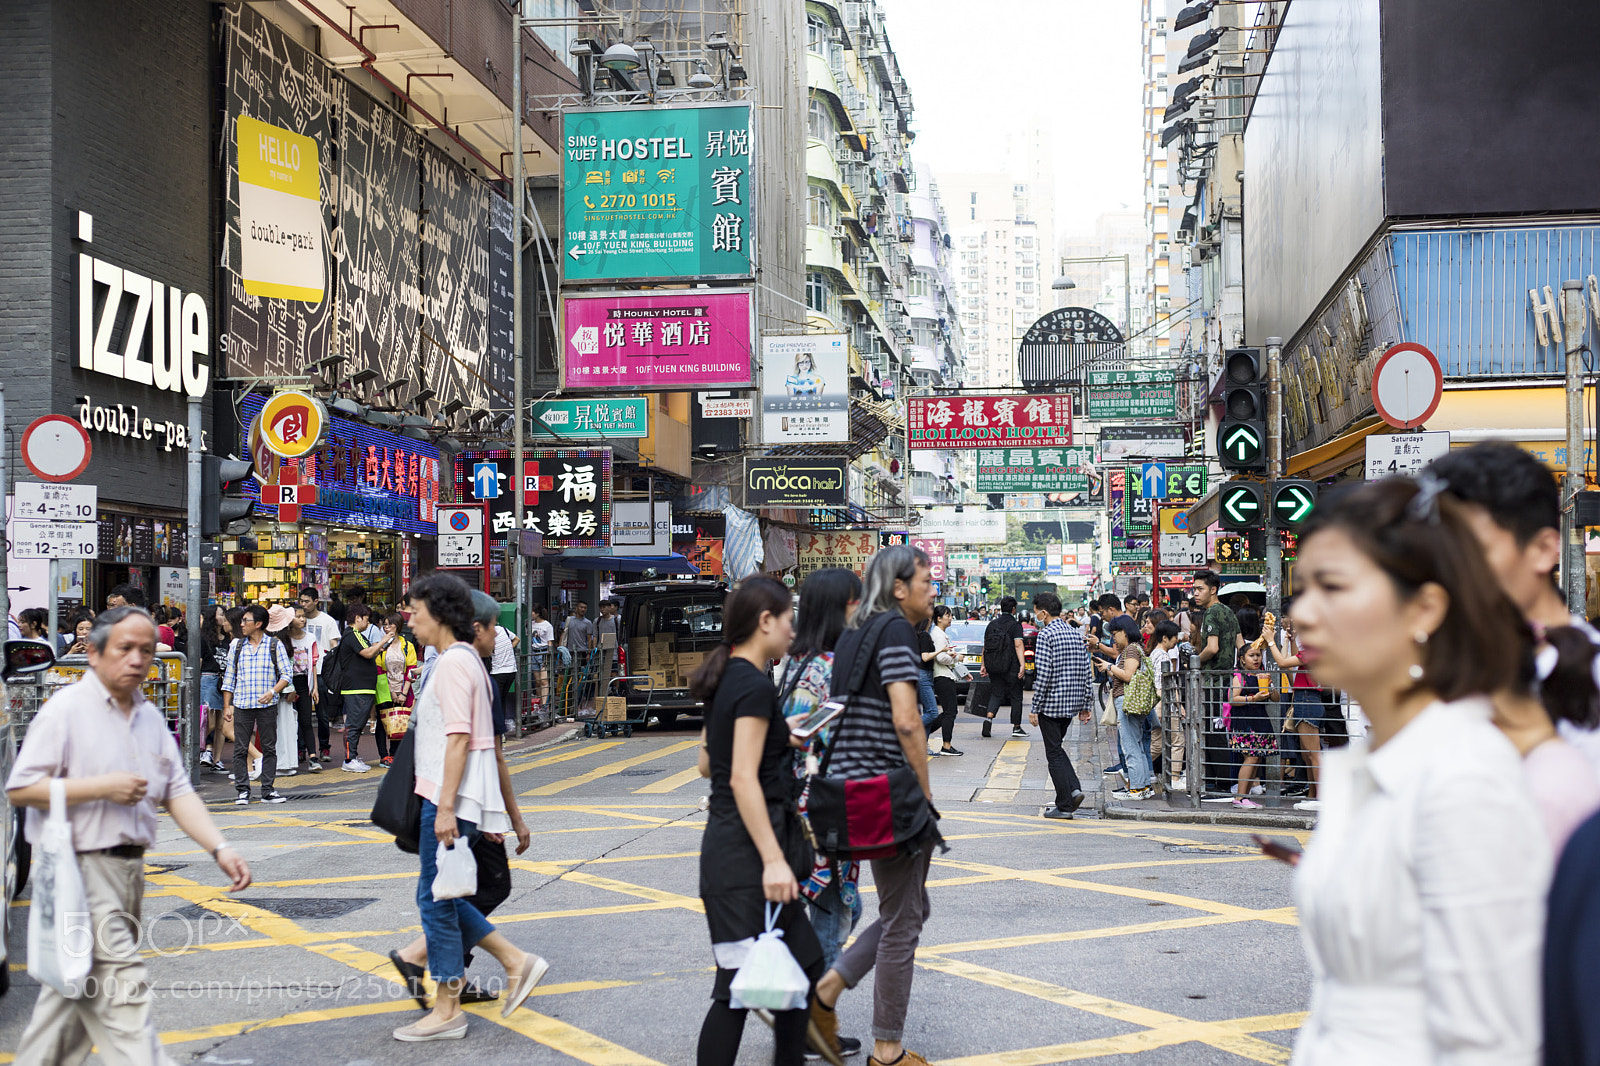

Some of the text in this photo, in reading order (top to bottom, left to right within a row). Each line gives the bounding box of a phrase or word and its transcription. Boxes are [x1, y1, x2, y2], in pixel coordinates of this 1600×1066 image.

[282, 65, 304, 129] Canal
[568, 135, 597, 148] SING
[259, 133, 300, 172] HELLO
[602, 137, 692, 160] HOSTEL
[568, 149, 597, 162] YUET
[601, 193, 676, 208] 2770 1015
[251, 220, 315, 251] double-park
[604, 241, 627, 249] YUEN
[631, 240, 650, 248] KING
[653, 239, 694, 248] BUILDING
[441, 272, 449, 295] 22
[79, 210, 209, 397] izzue
[624, 310, 660, 318] HOURLY
[663, 309, 692, 317] HOTEL
[573, 367, 591, 375] 10樓
[635, 366, 651, 374] 10/F
[654, 365, 677, 374] YUEN
[679, 364, 699, 372] KING
[702, 363, 741, 372] BUILDING
[1091, 390, 1173, 400] REGENG HOTEL
[927, 399, 1053, 427] 海龍賓館
[80, 396, 207, 451] double-pak
[911, 426, 1069, 440] HOI LOON HOTEL
[1391, 435, 1424, 443] Saturdays
[1393, 445, 1420, 455] 星期六
[1369, 468, 1385, 476] 下午
[757, 475, 836, 490] moca hair
[1168, 473, 1182, 494] £
[1186, 473, 1200, 495] €
[43, 491, 69, 500] 星期六
[19, 508, 34, 516] 下午
[76, 505, 92, 516] 10
[466, 537, 473, 547] 7
[928, 540, 942, 554] ¥
[1190, 536, 1197, 546] 7
[60, 548, 75, 556] 下午
[79, 543, 94, 555] 10
[1221, 542, 1232, 558] $
[467, 553, 480, 564] 12
[1190, 553, 1204, 564] 12
[930, 565, 943, 579] €
